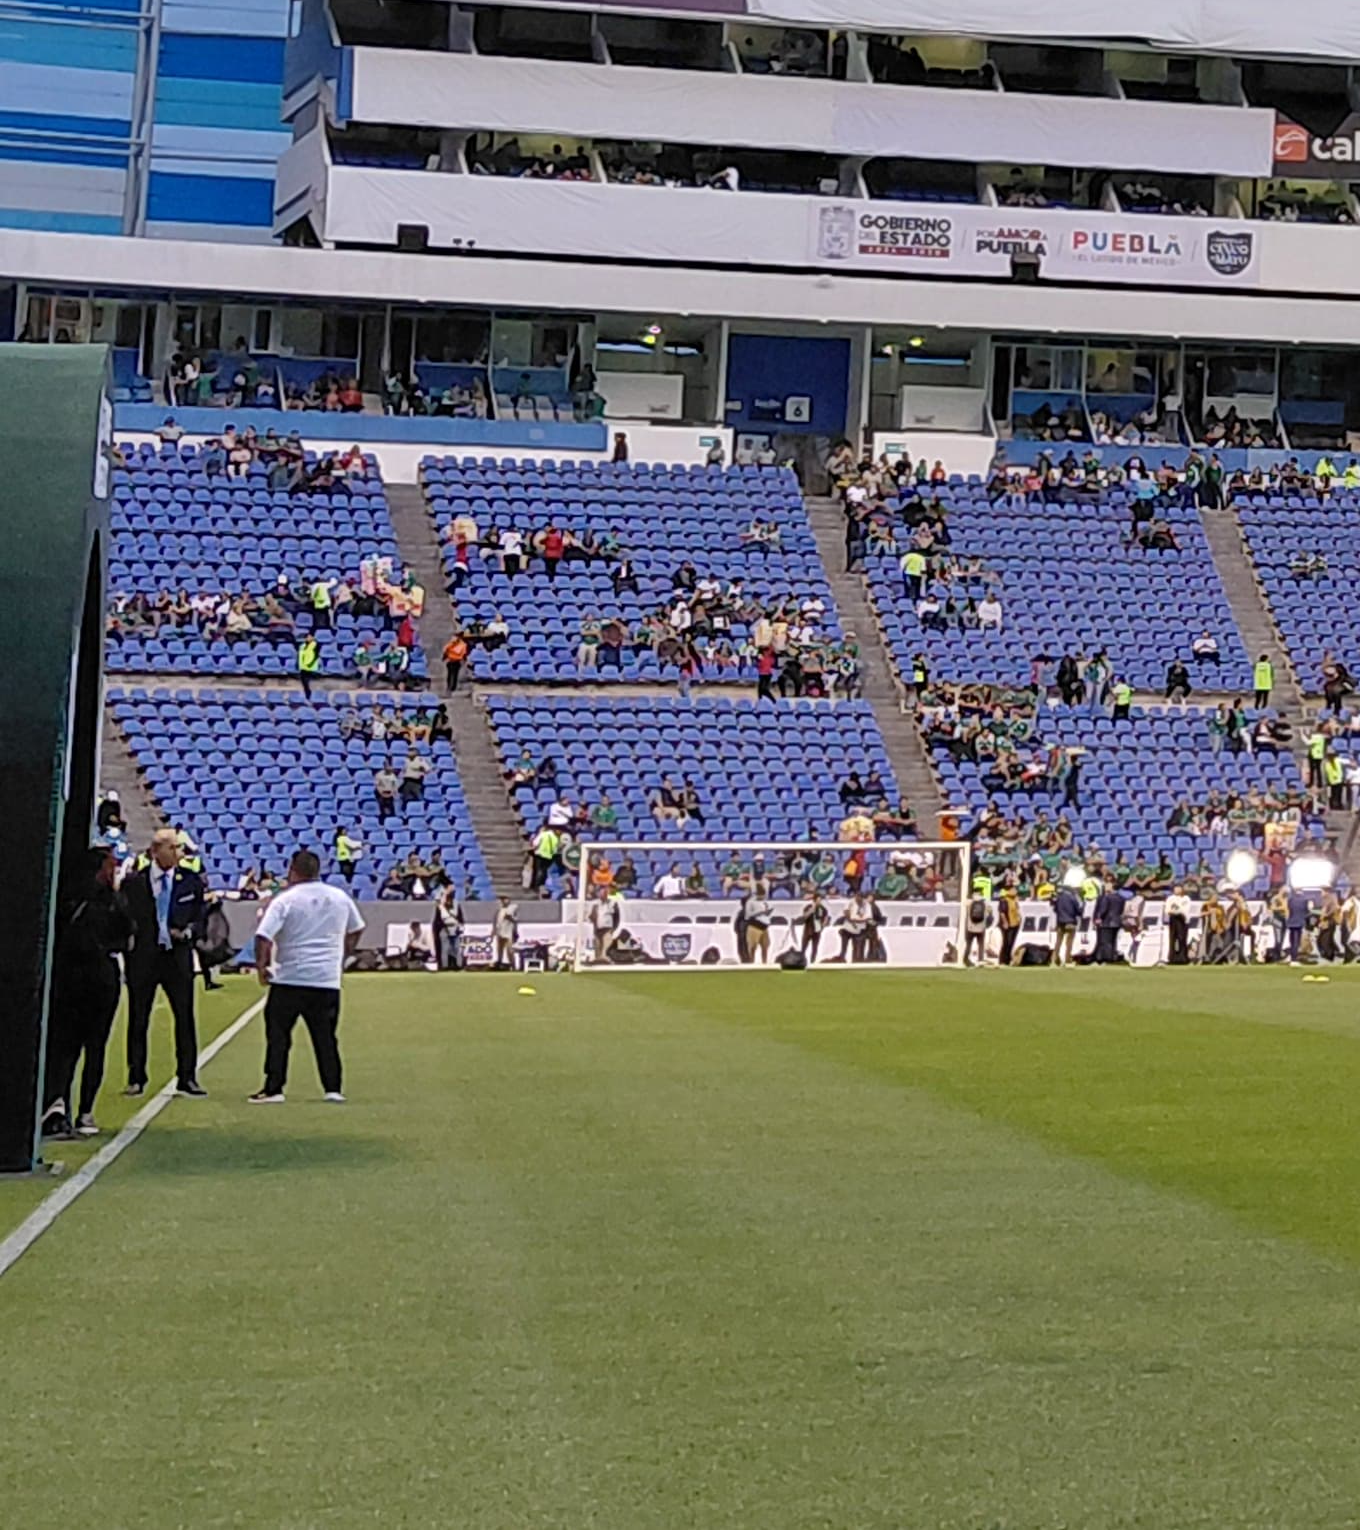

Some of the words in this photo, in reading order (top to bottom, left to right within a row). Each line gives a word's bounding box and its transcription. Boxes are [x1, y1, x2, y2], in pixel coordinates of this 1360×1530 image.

[860, 214, 952, 233] GOBIERNO
[879, 231, 951, 247] ESTADO
[1073, 231, 1182, 256] PUEBLA
